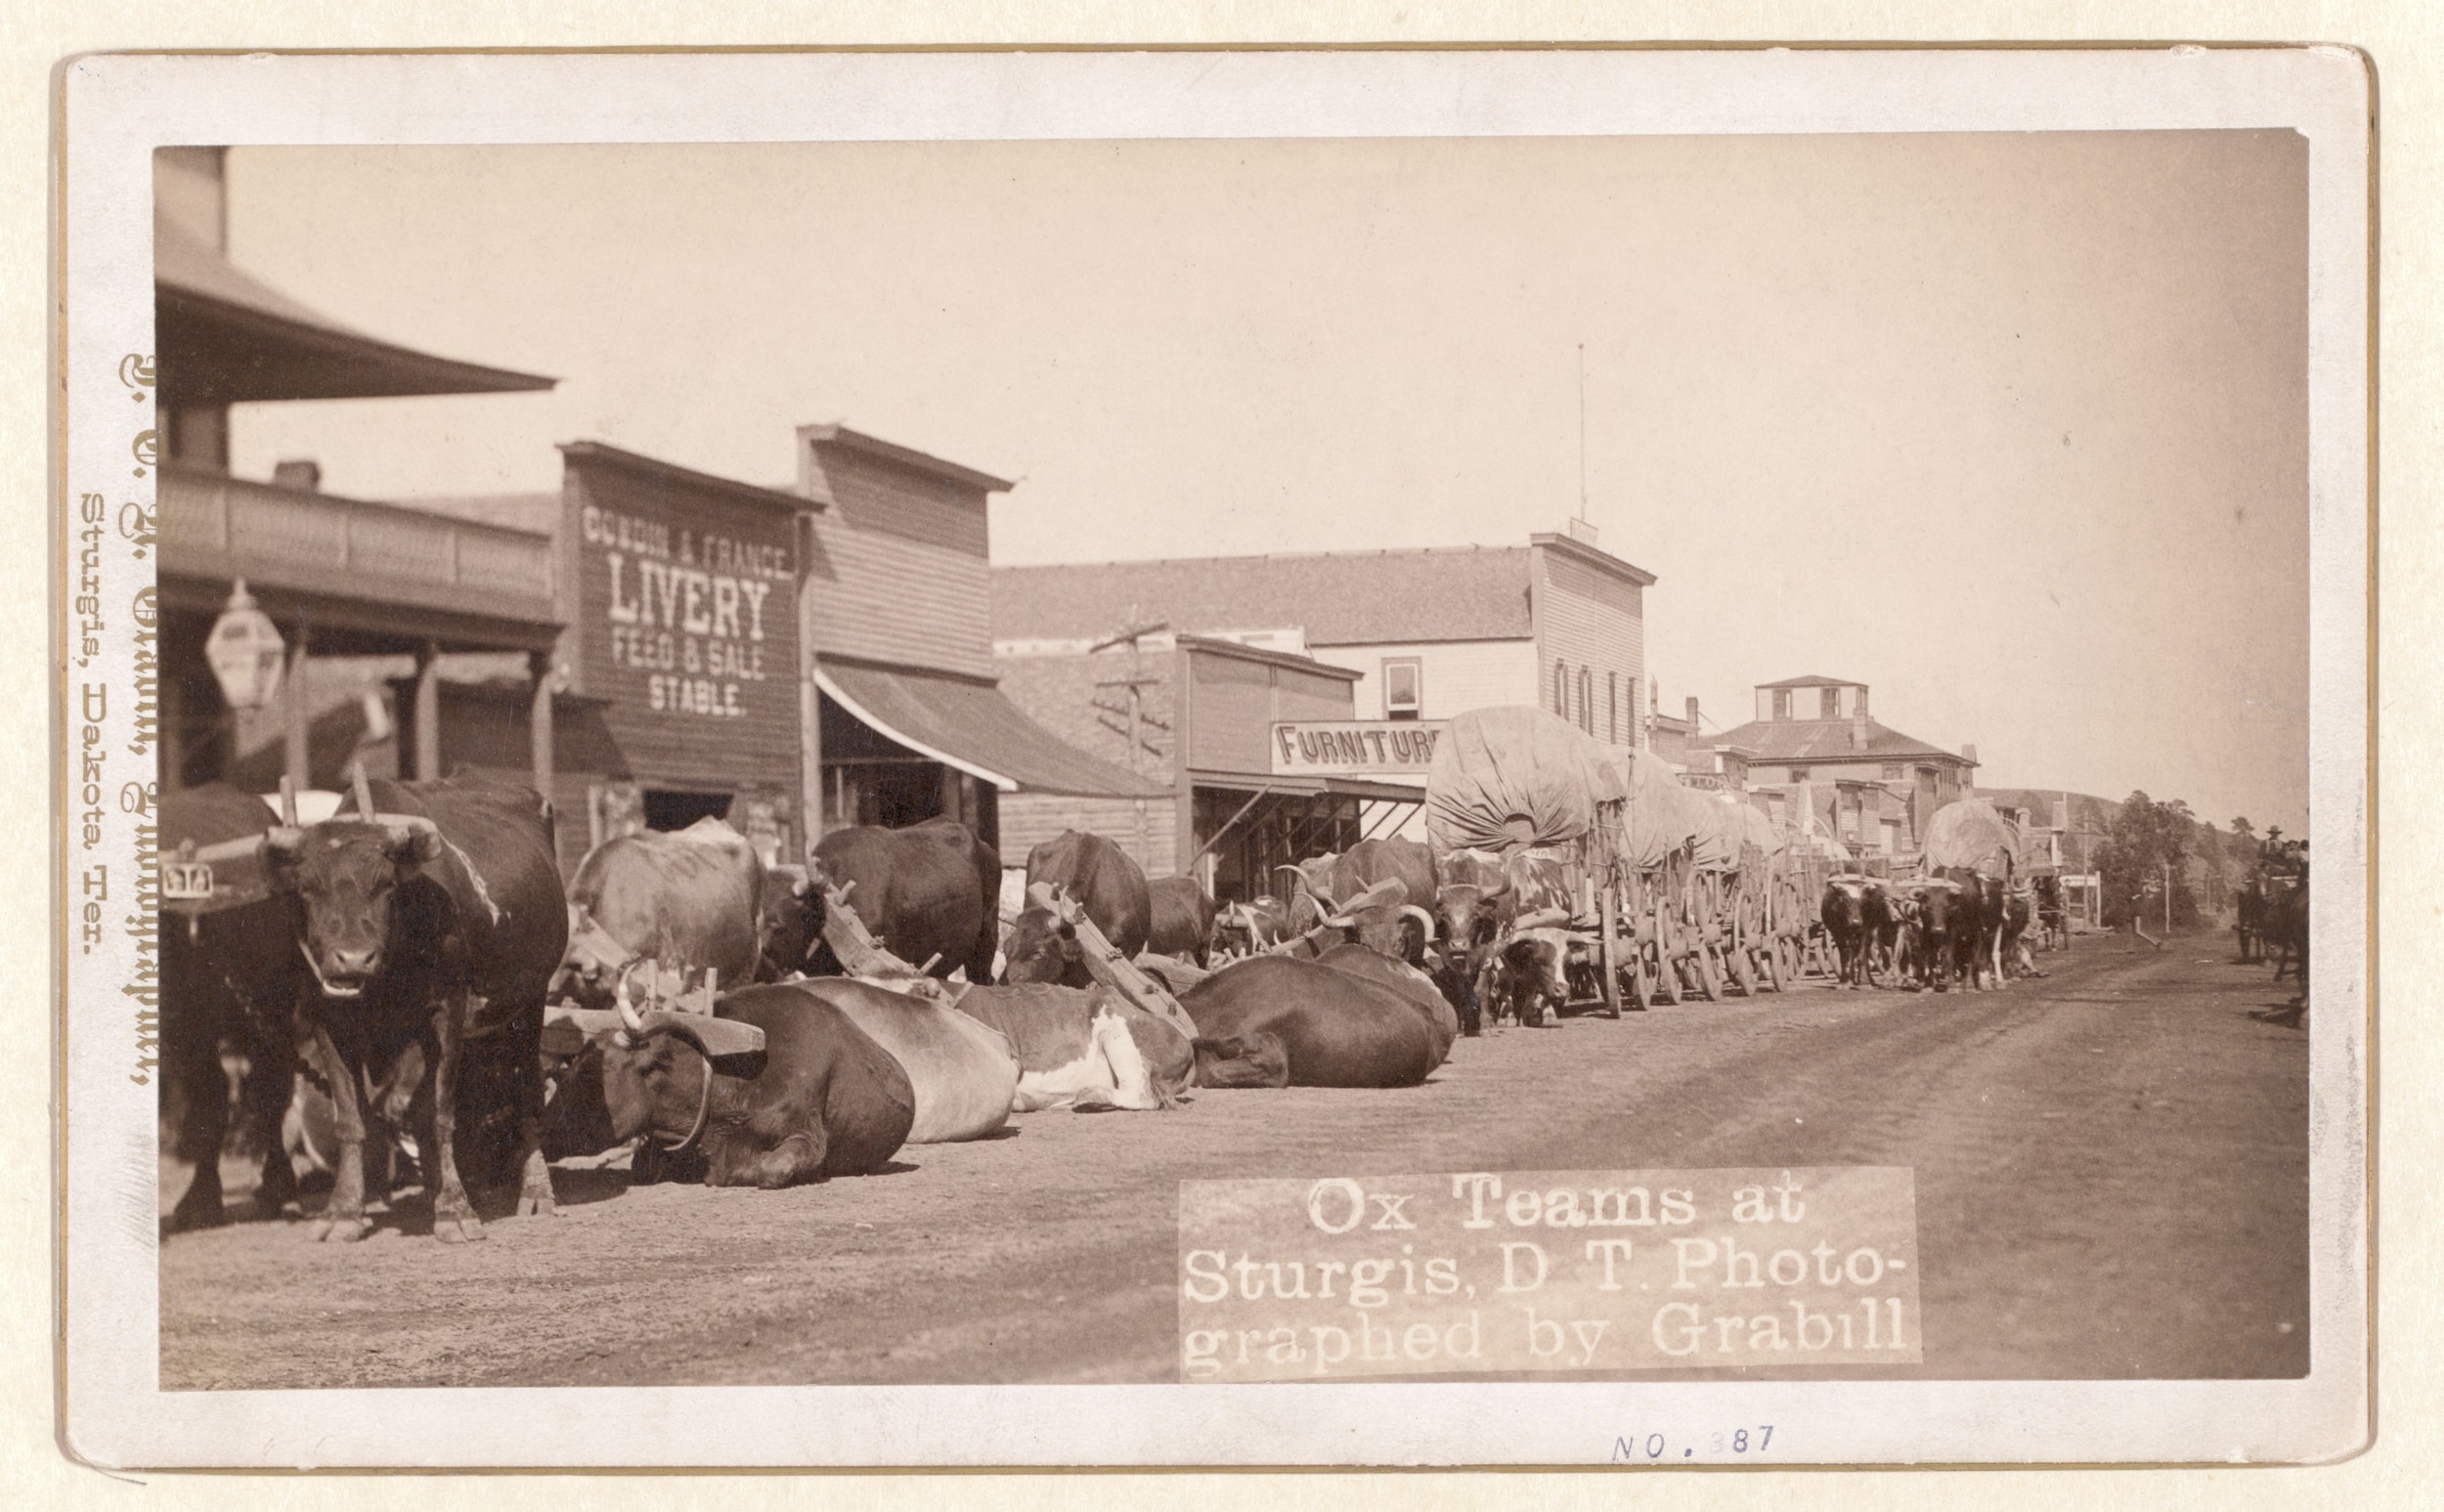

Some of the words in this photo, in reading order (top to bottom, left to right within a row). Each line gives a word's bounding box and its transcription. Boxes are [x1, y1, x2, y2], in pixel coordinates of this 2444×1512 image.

[75, 493, 105, 669] Sturgis,
[607, 552, 771, 642] LIVERY
[612, 626, 675, 671] FEED
[683, 636, 702, 674] &
[707, 638, 766, 681] SALE
[82, 682, 107, 849] Dakota
[82, 865, 107, 955] Ter.
[1612, 1433, 1693, 1461] NO.
